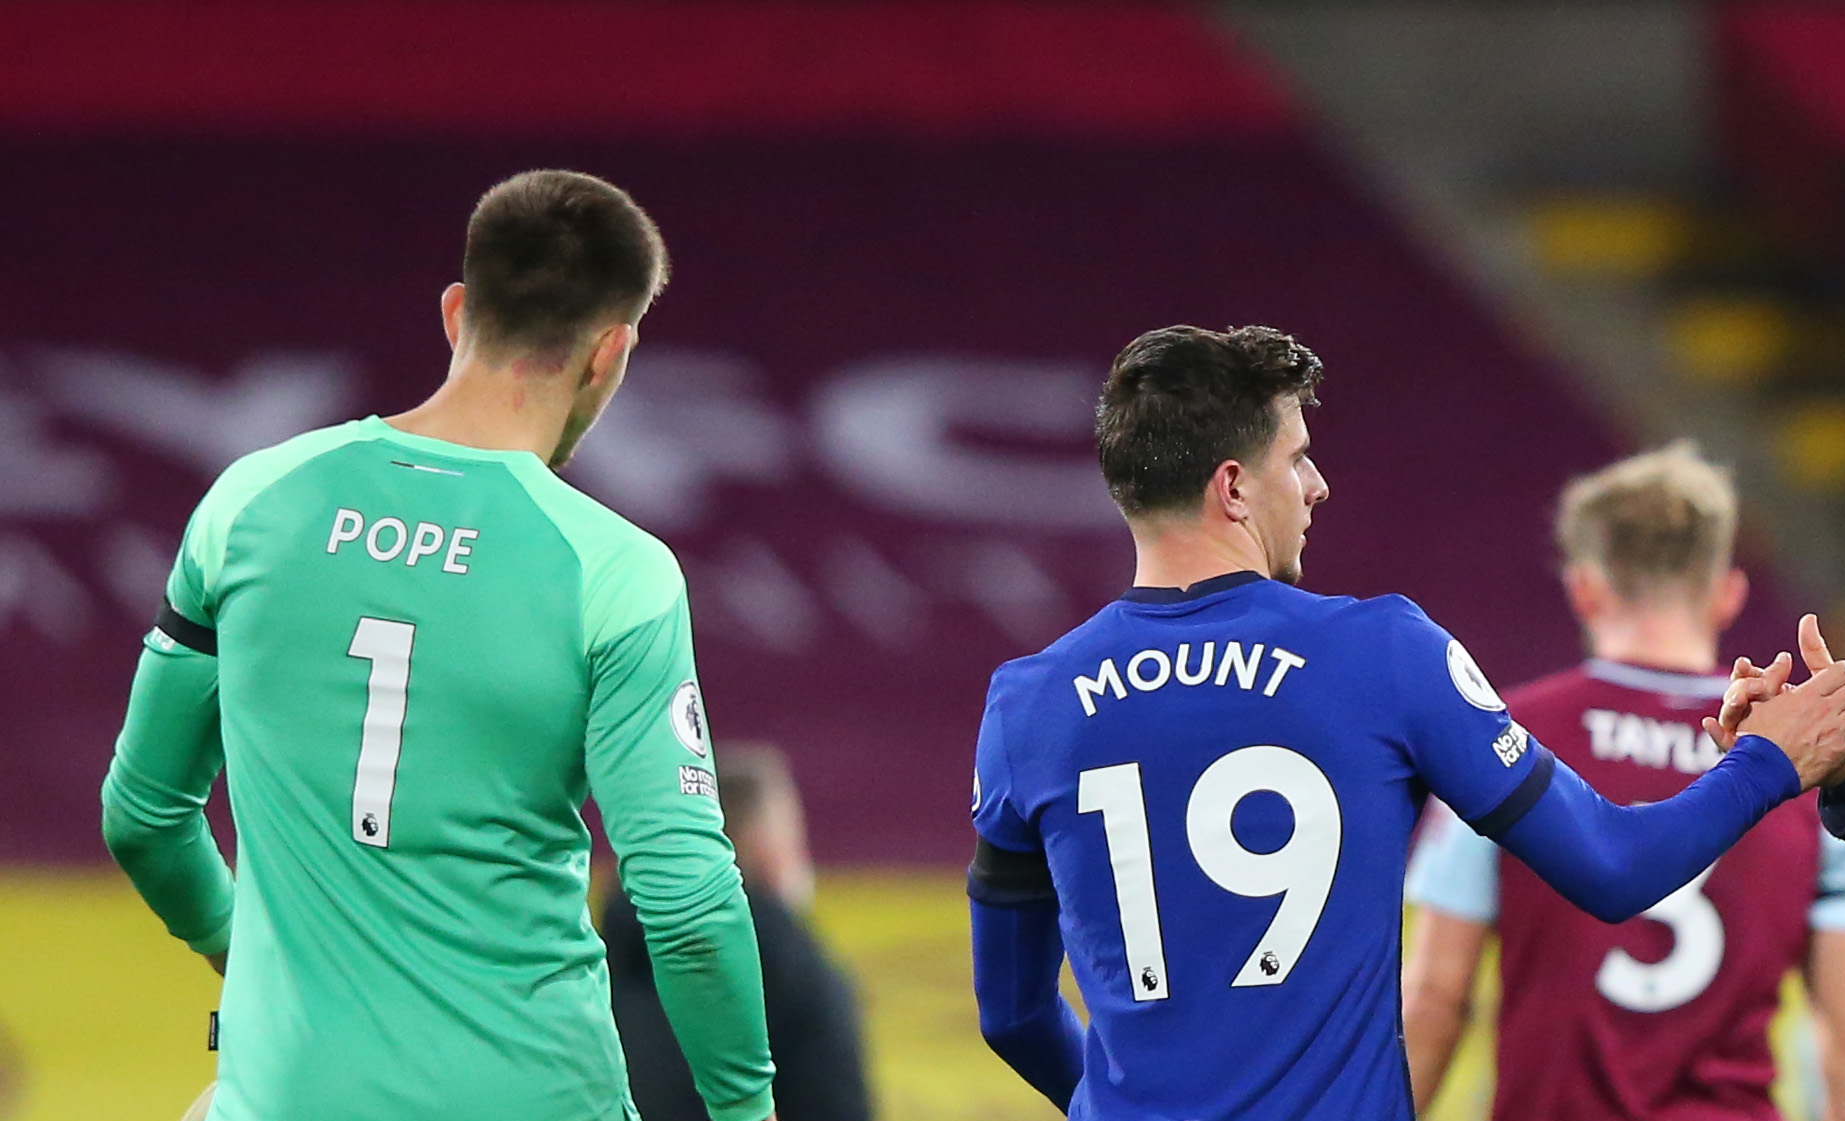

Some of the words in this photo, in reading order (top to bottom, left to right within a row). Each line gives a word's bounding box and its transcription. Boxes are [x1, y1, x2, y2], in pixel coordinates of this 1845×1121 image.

[326, 508, 479, 574] POPE
[348, 616, 416, 848] 1
[1073, 641, 1306, 717] MOUNT
[1077, 745, 1342, 1001] 19
[1595, 825, 1726, 1014] 3
